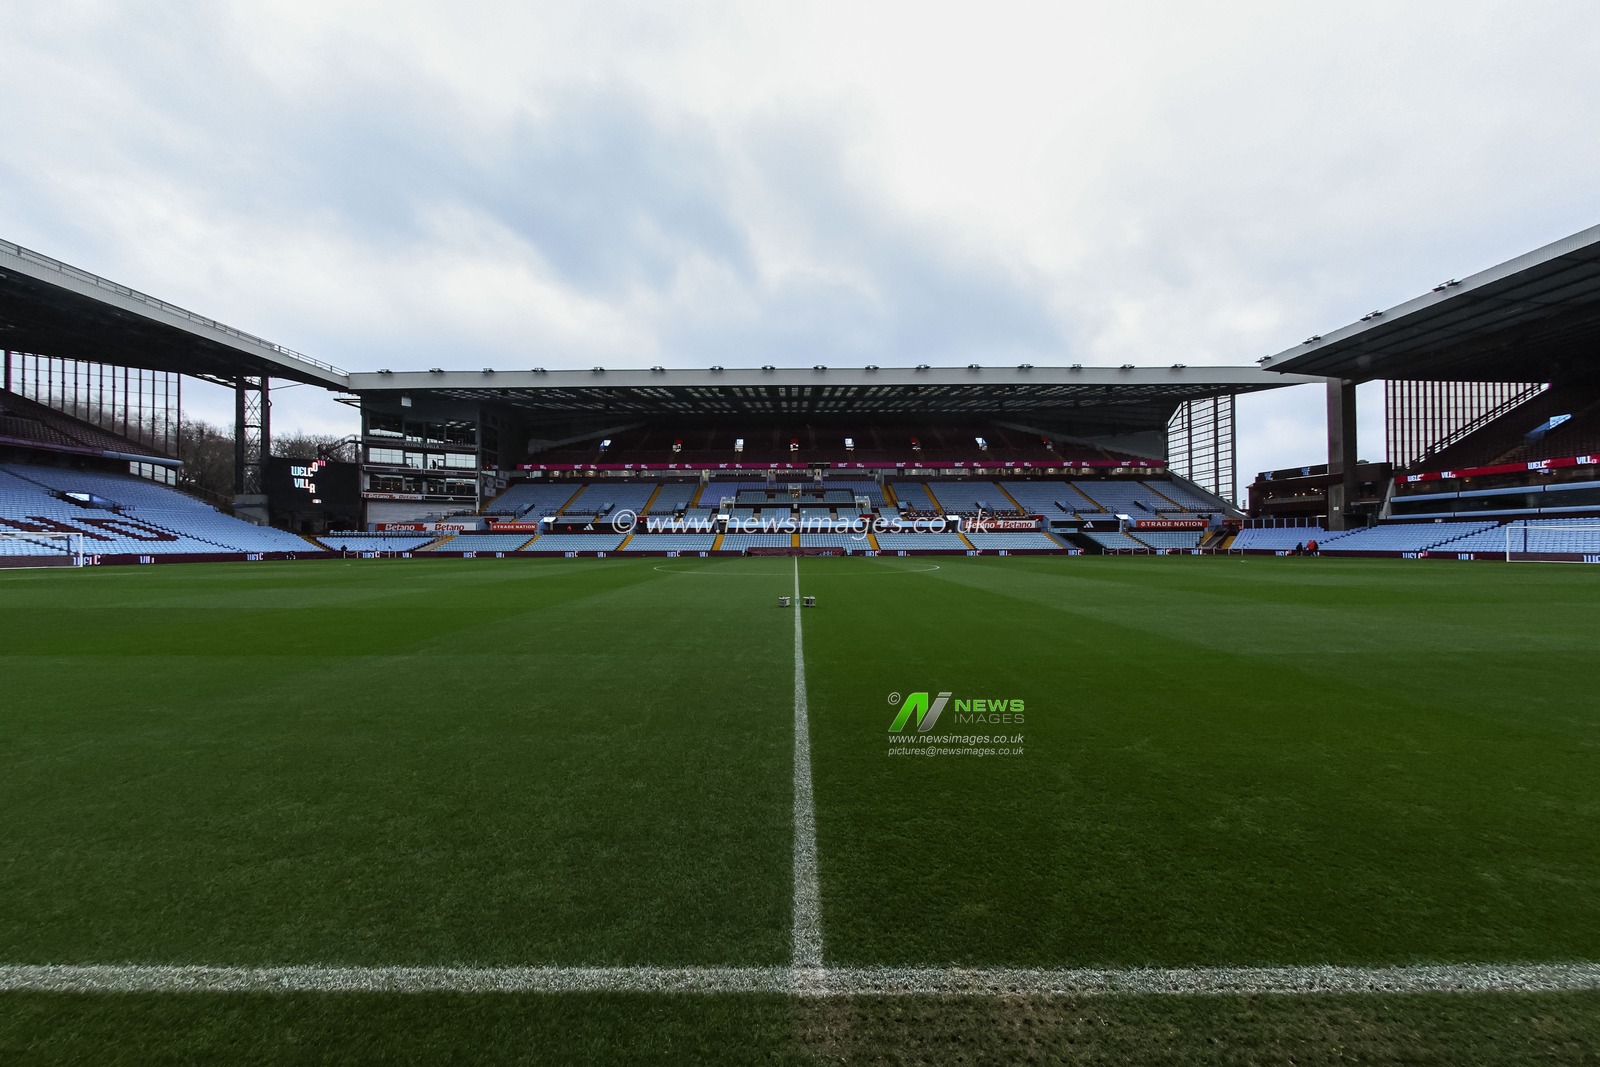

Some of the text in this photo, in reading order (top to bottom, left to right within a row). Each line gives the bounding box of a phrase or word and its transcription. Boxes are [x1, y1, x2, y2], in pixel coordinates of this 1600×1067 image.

[294, 478, 316, 493] VILLA
[385, 523, 416, 531] Betano
[435, 523, 464, 531] Betano
[1003, 520, 1033, 529] Betano
